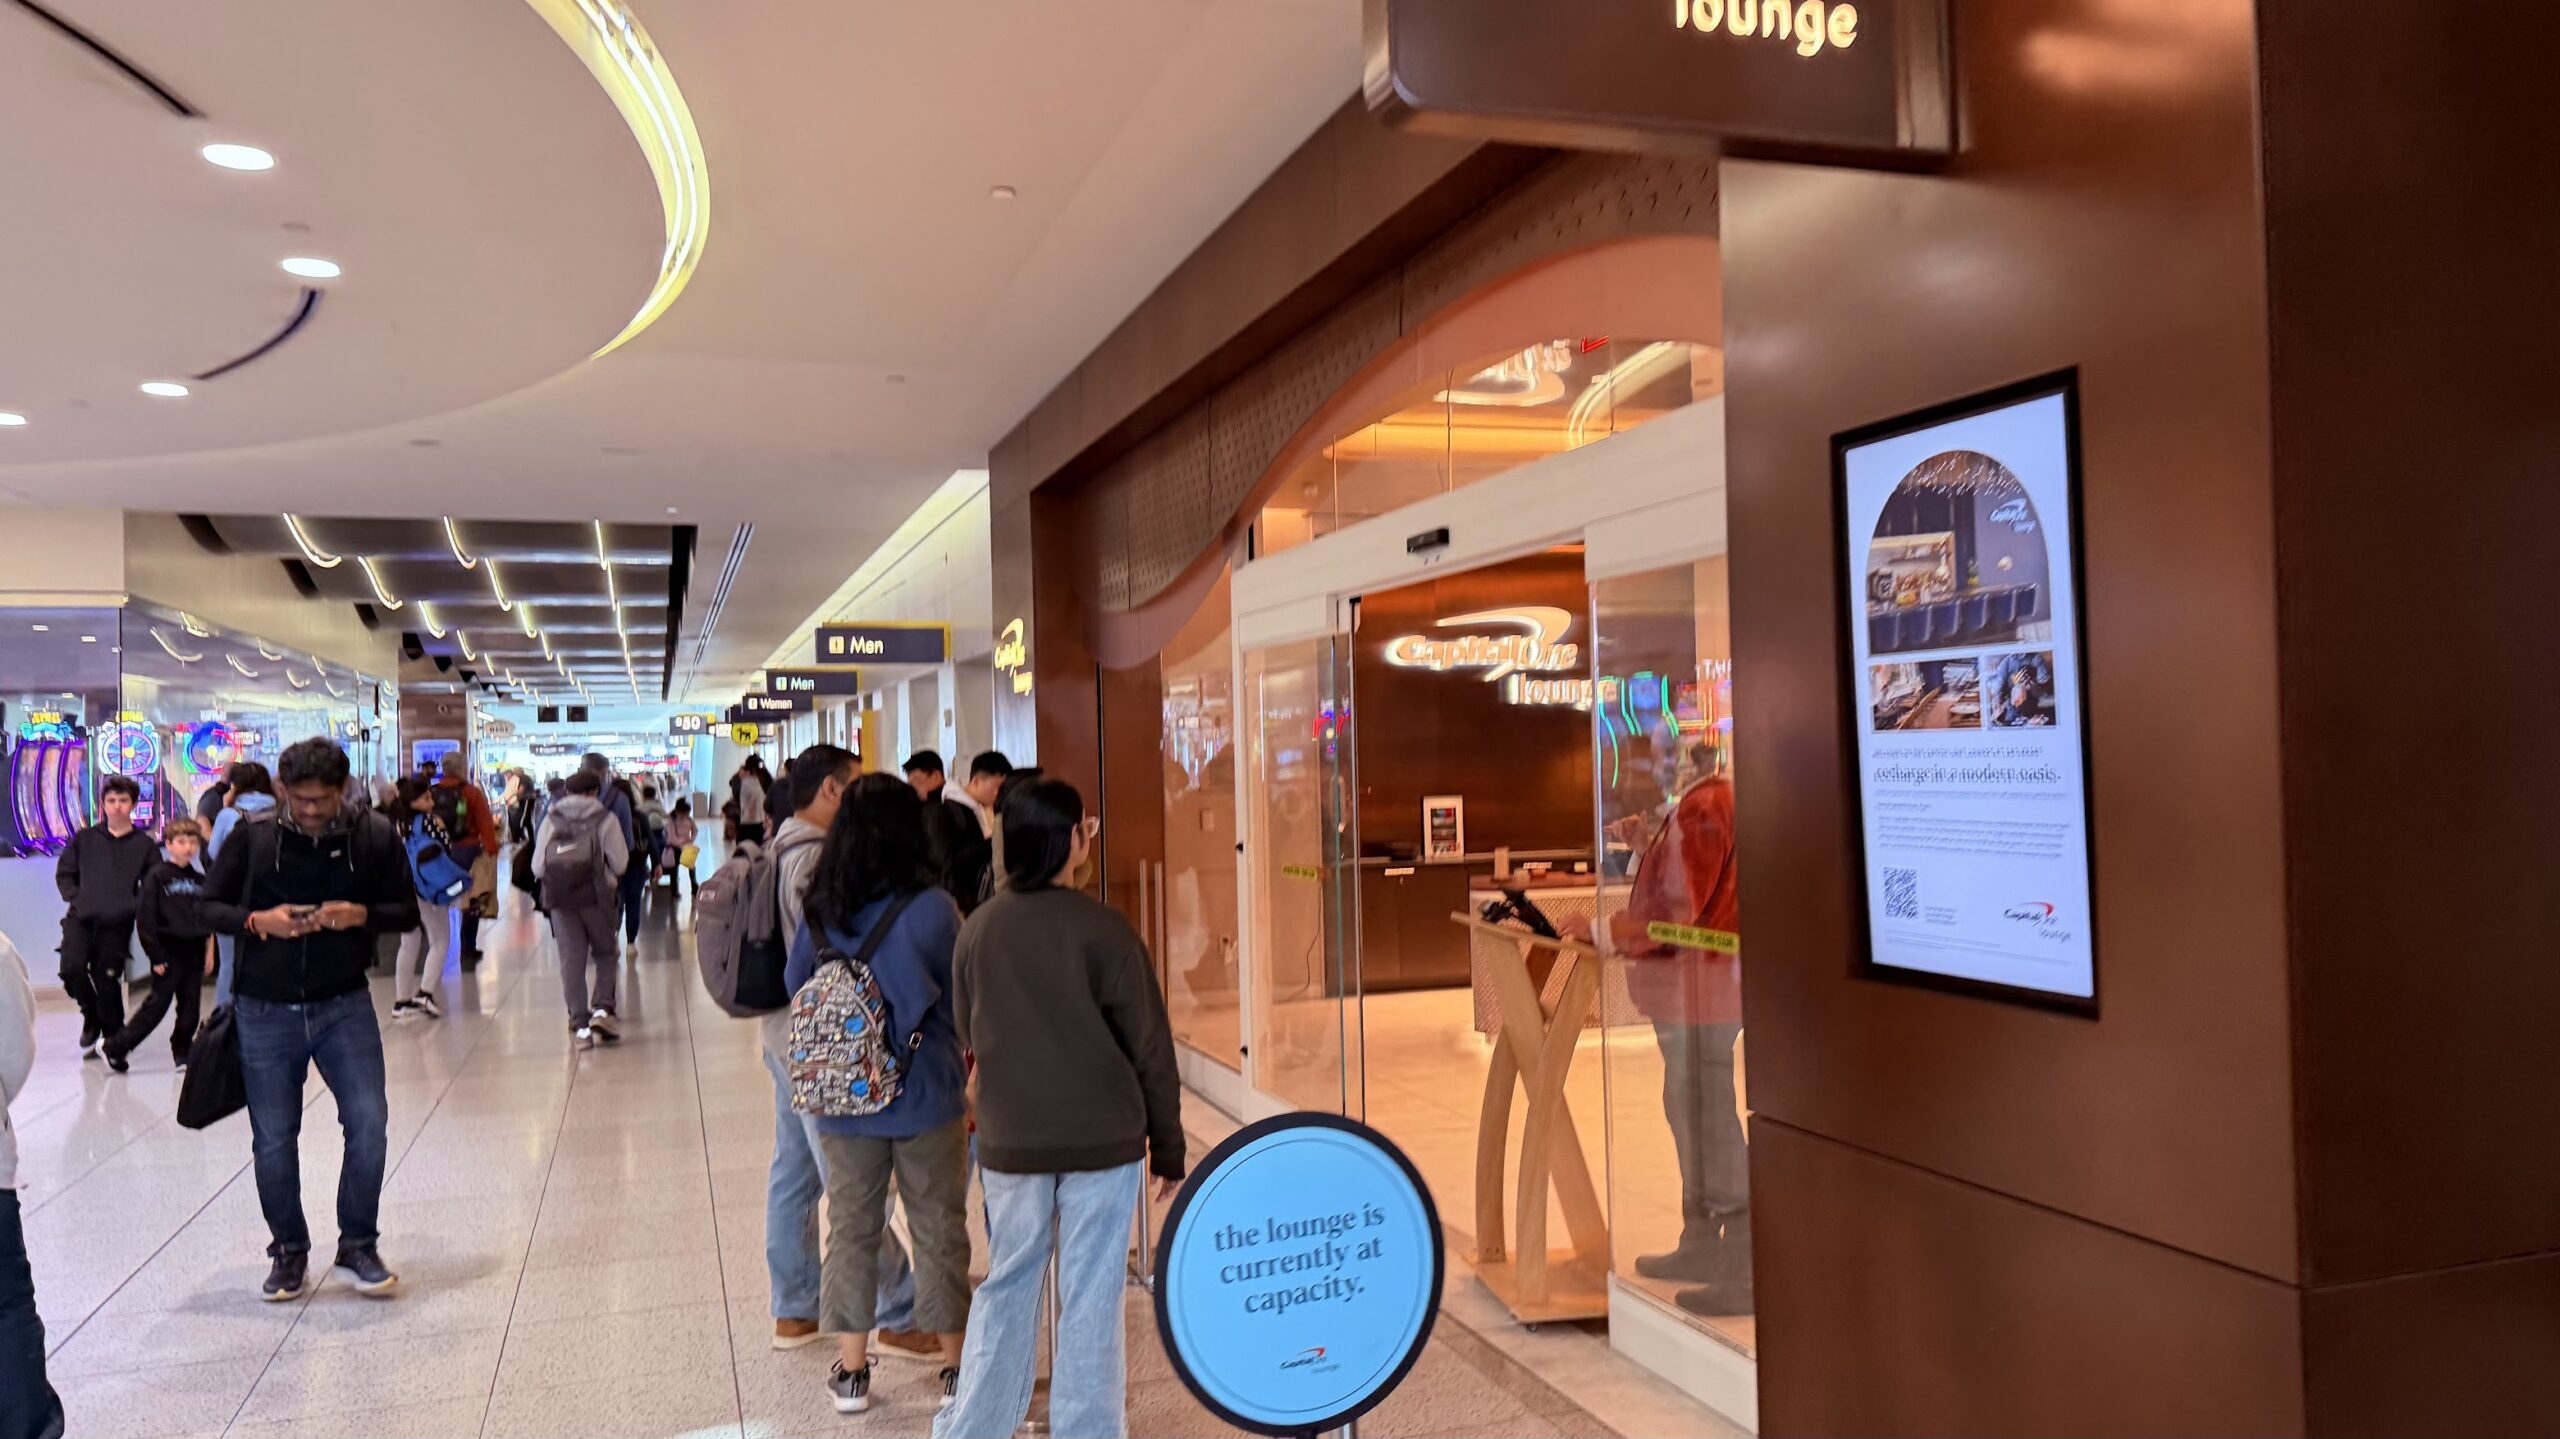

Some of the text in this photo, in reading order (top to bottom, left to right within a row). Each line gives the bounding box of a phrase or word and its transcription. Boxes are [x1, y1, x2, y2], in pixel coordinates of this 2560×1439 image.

[850, 635, 884, 655] Men
[1387, 634, 1521, 671] Capital
[790, 676, 815, 691] Men
[760, 697, 793, 710] Women
[1214, 1202, 1386, 1252] the lounge is
[1220, 1236, 1384, 1285] currently at
[1244, 1273, 1366, 1316] capacity.
